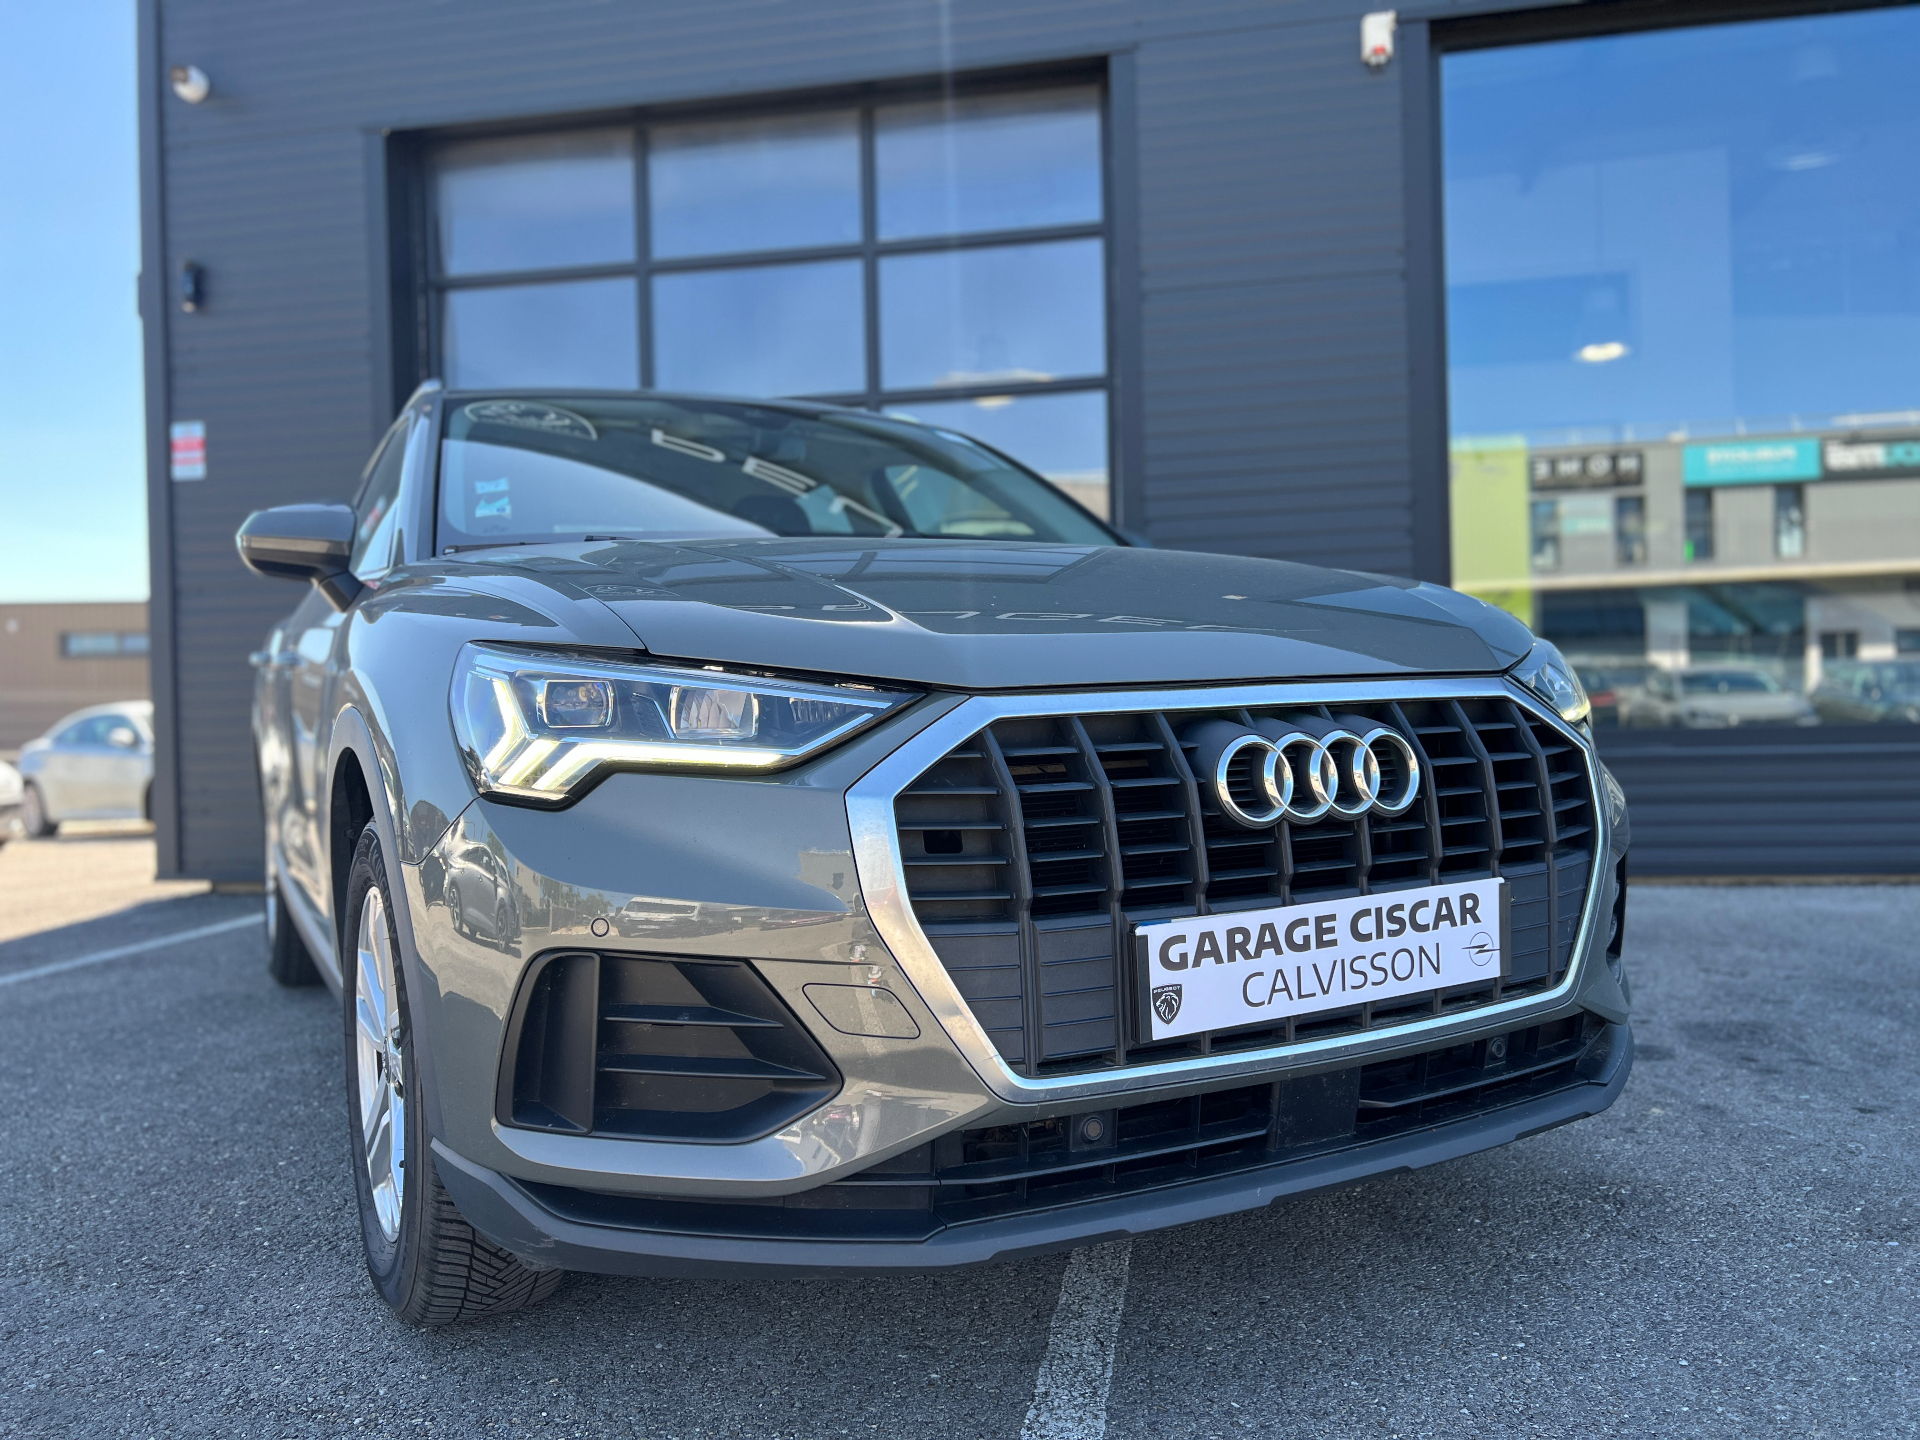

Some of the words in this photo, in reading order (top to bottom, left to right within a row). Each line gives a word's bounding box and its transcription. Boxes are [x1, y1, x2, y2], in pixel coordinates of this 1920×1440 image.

[1158, 912, 1339, 972] GARAGE
[1349, 892, 1482, 943] CISCAR
[1242, 942, 1441, 1008] CALVISSON
